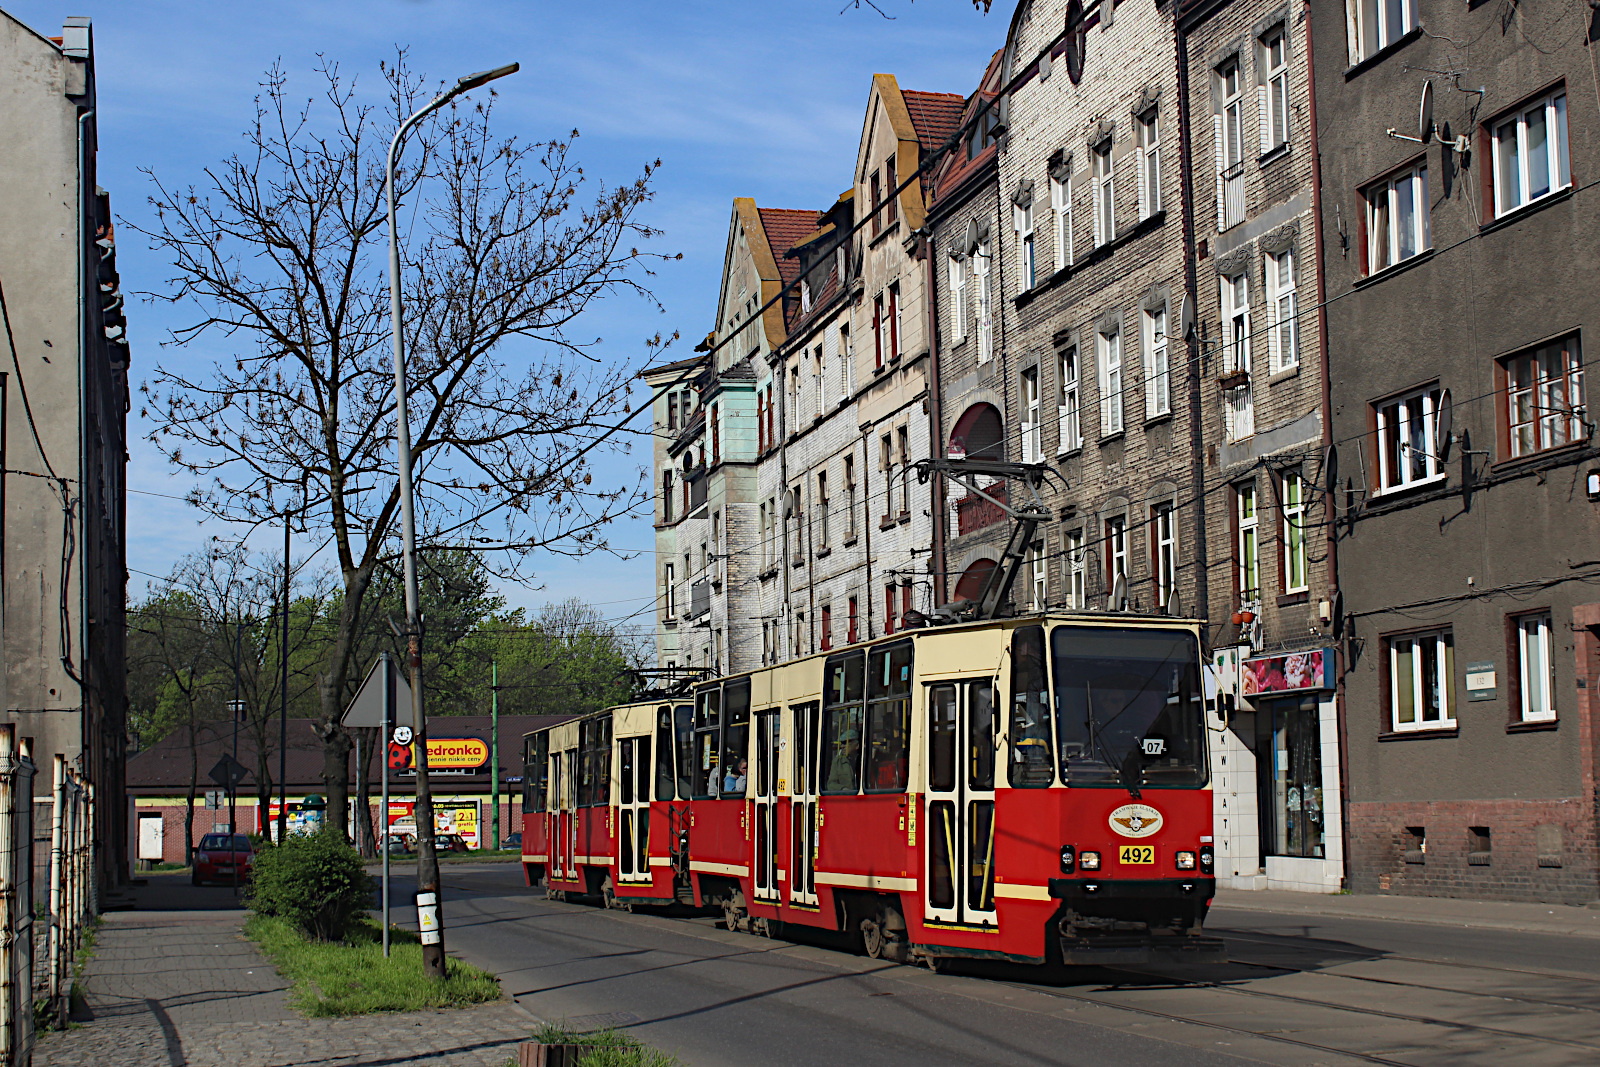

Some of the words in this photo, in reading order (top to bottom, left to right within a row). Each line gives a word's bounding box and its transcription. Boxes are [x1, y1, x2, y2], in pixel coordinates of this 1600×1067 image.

[427, 744, 481, 756] edronka
[1146, 742, 1160, 753] 07
[1220, 735, 1228, 850] KWIATY
[1112, 805, 1138, 817] TRAMWAJE
[1139, 803, 1159, 817] ŚLĄSKIE
[1121, 848, 1152, 863] 492
